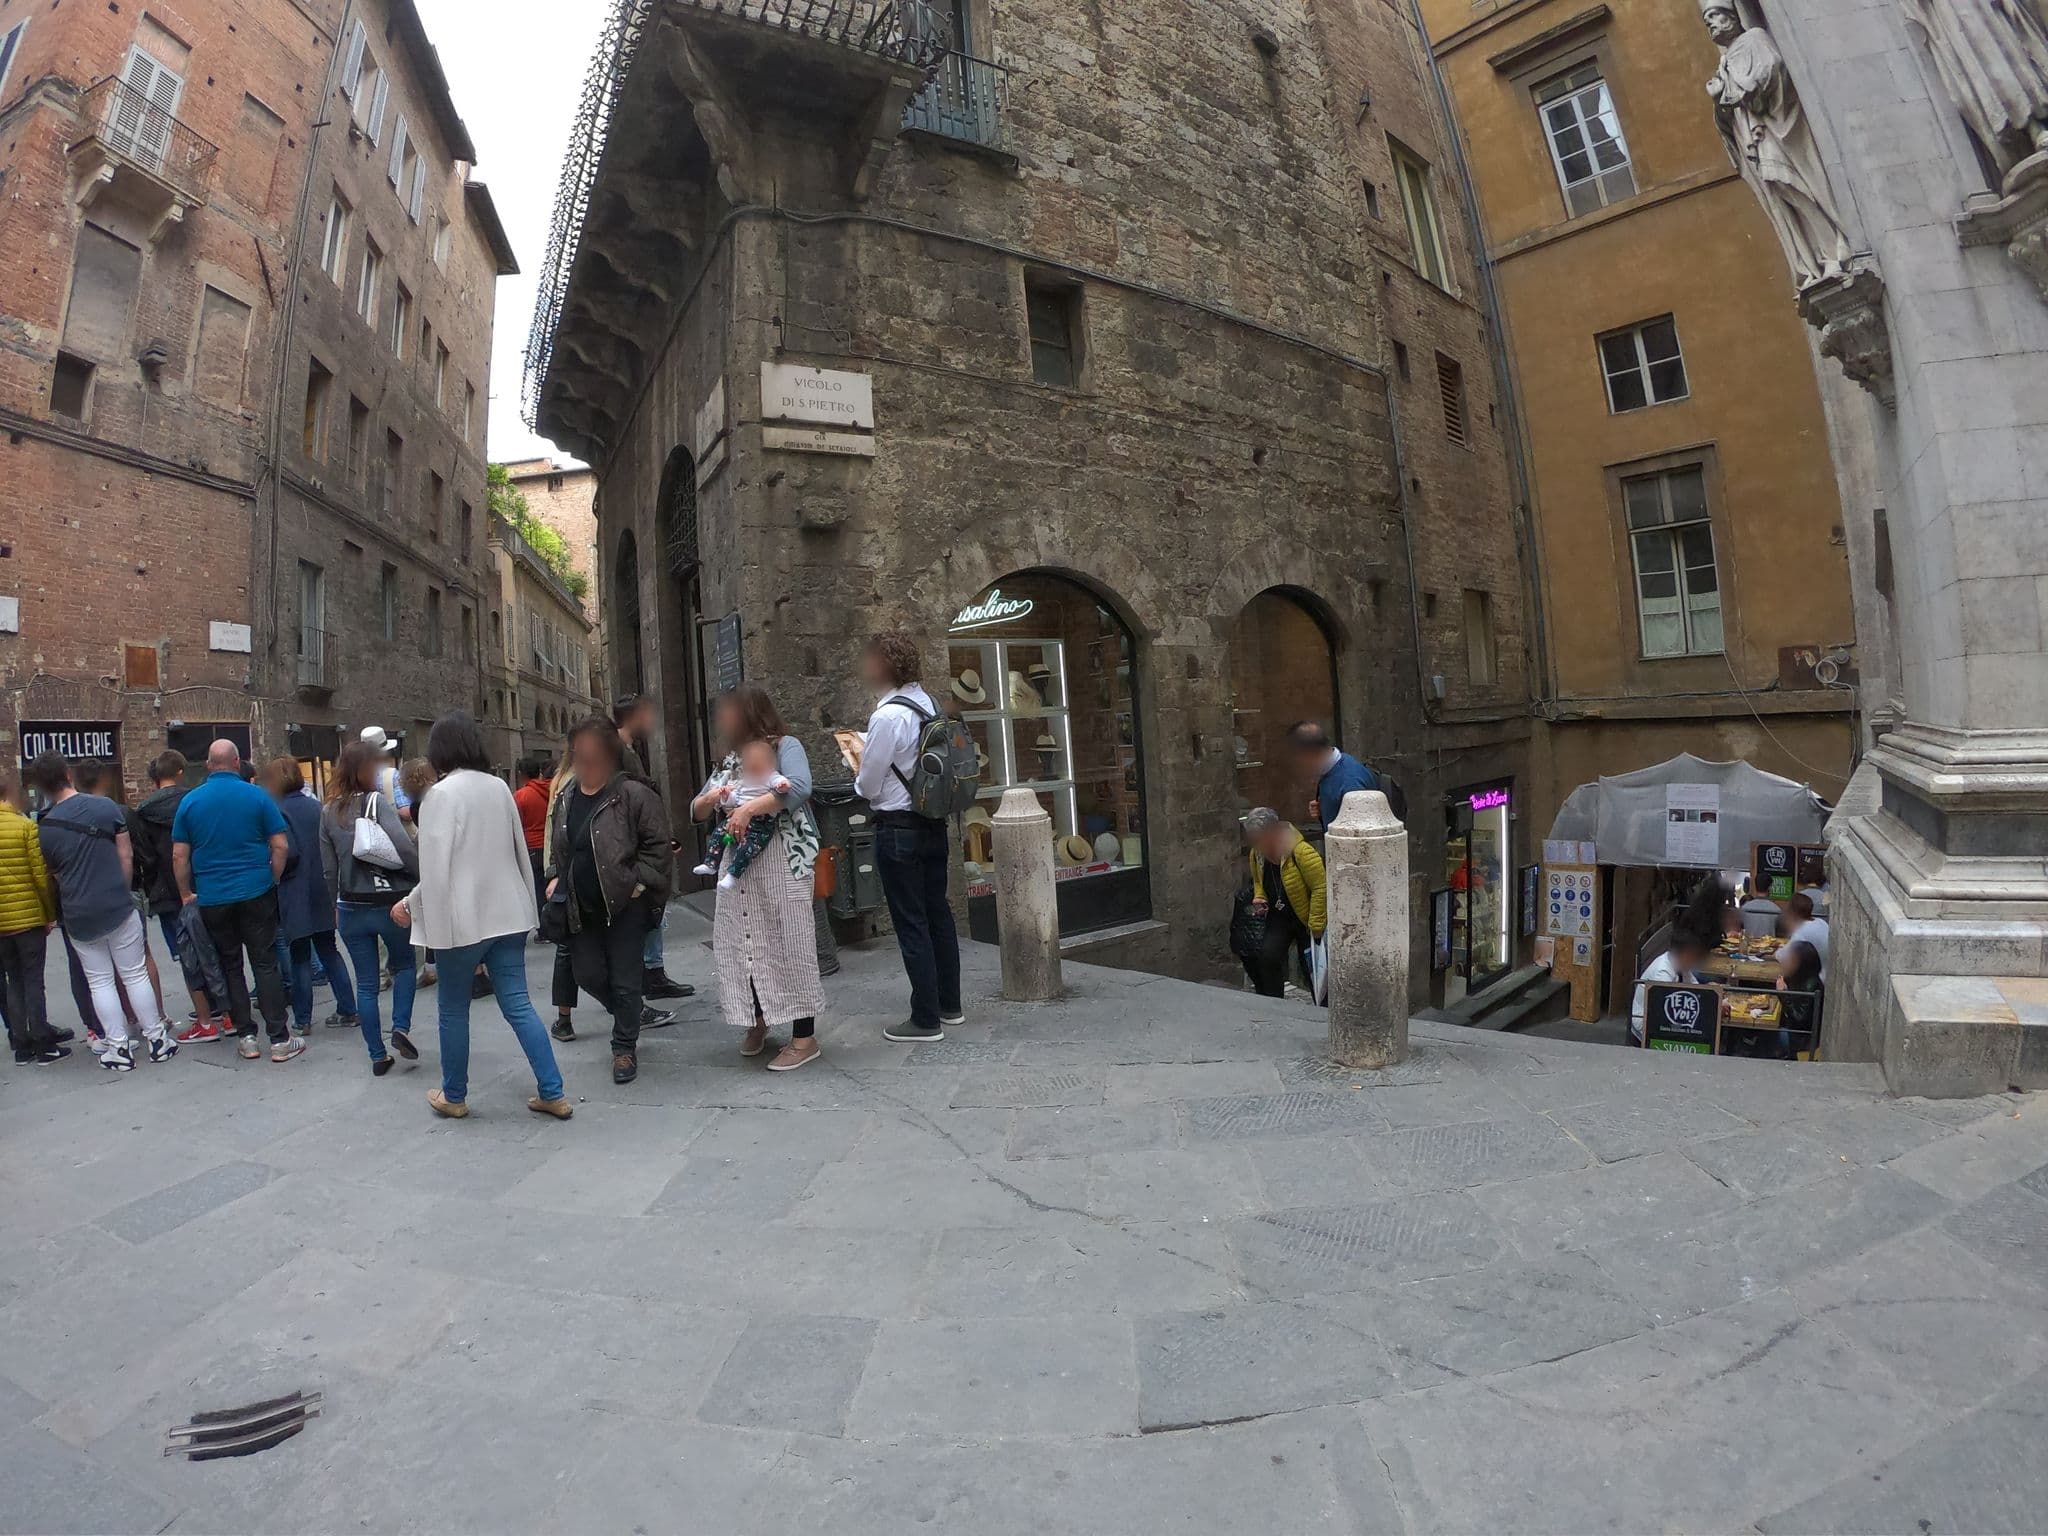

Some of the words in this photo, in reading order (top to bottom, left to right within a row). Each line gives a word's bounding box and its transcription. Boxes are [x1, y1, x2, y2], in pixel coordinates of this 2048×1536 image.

[794, 378, 842, 392] VICOLO
[782, 397, 794, 407] DI
[1055, 866, 1084, 881] ENTRANCE
[967, 883, 993, 898] TRANCE
[1669, 994, 1682, 1008] TE
[1683, 995, 1696, 1011] KE
[1672, 1008, 1697, 1023] VOI?
[1663, 1043, 1697, 1055] SIAMO
